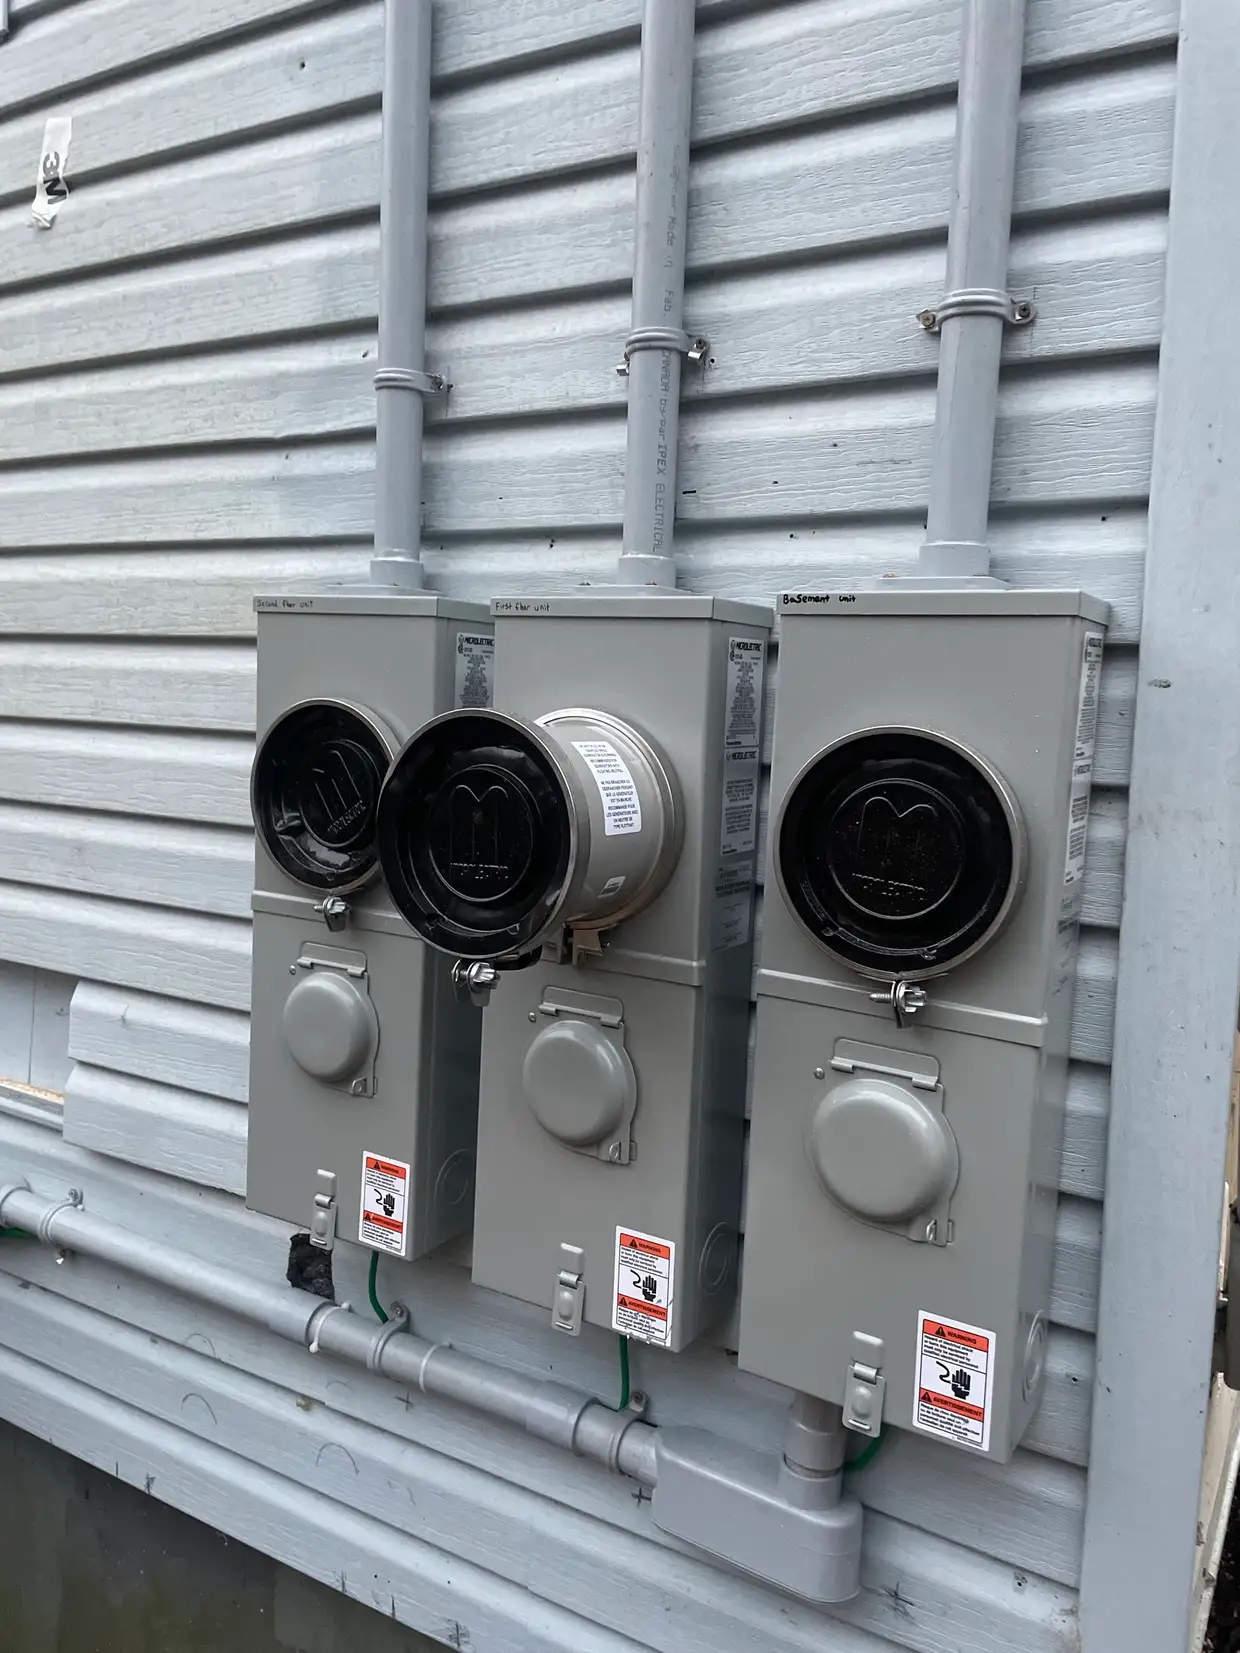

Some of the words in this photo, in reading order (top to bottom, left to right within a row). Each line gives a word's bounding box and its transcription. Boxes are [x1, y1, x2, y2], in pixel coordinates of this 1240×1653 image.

[43, 151, 67, 205] 3M
[667, 216, 677, 247] Made
[664, 289, 674, 318] Fab.
[661, 350, 672, 392] CANADA
[657, 443, 668, 476] IPEX
[653, 483, 666, 552] ELECTRICAL
[496, 602, 512, 610] First
[534, 602, 550, 612] unit
[838, 594, 856, 602] unit
[638, 1243, 662, 1253] WARNING
[948, 1331, 977, 1344] WARNING
[933, 1397, 982, 1417] AVERTISSEMENT
